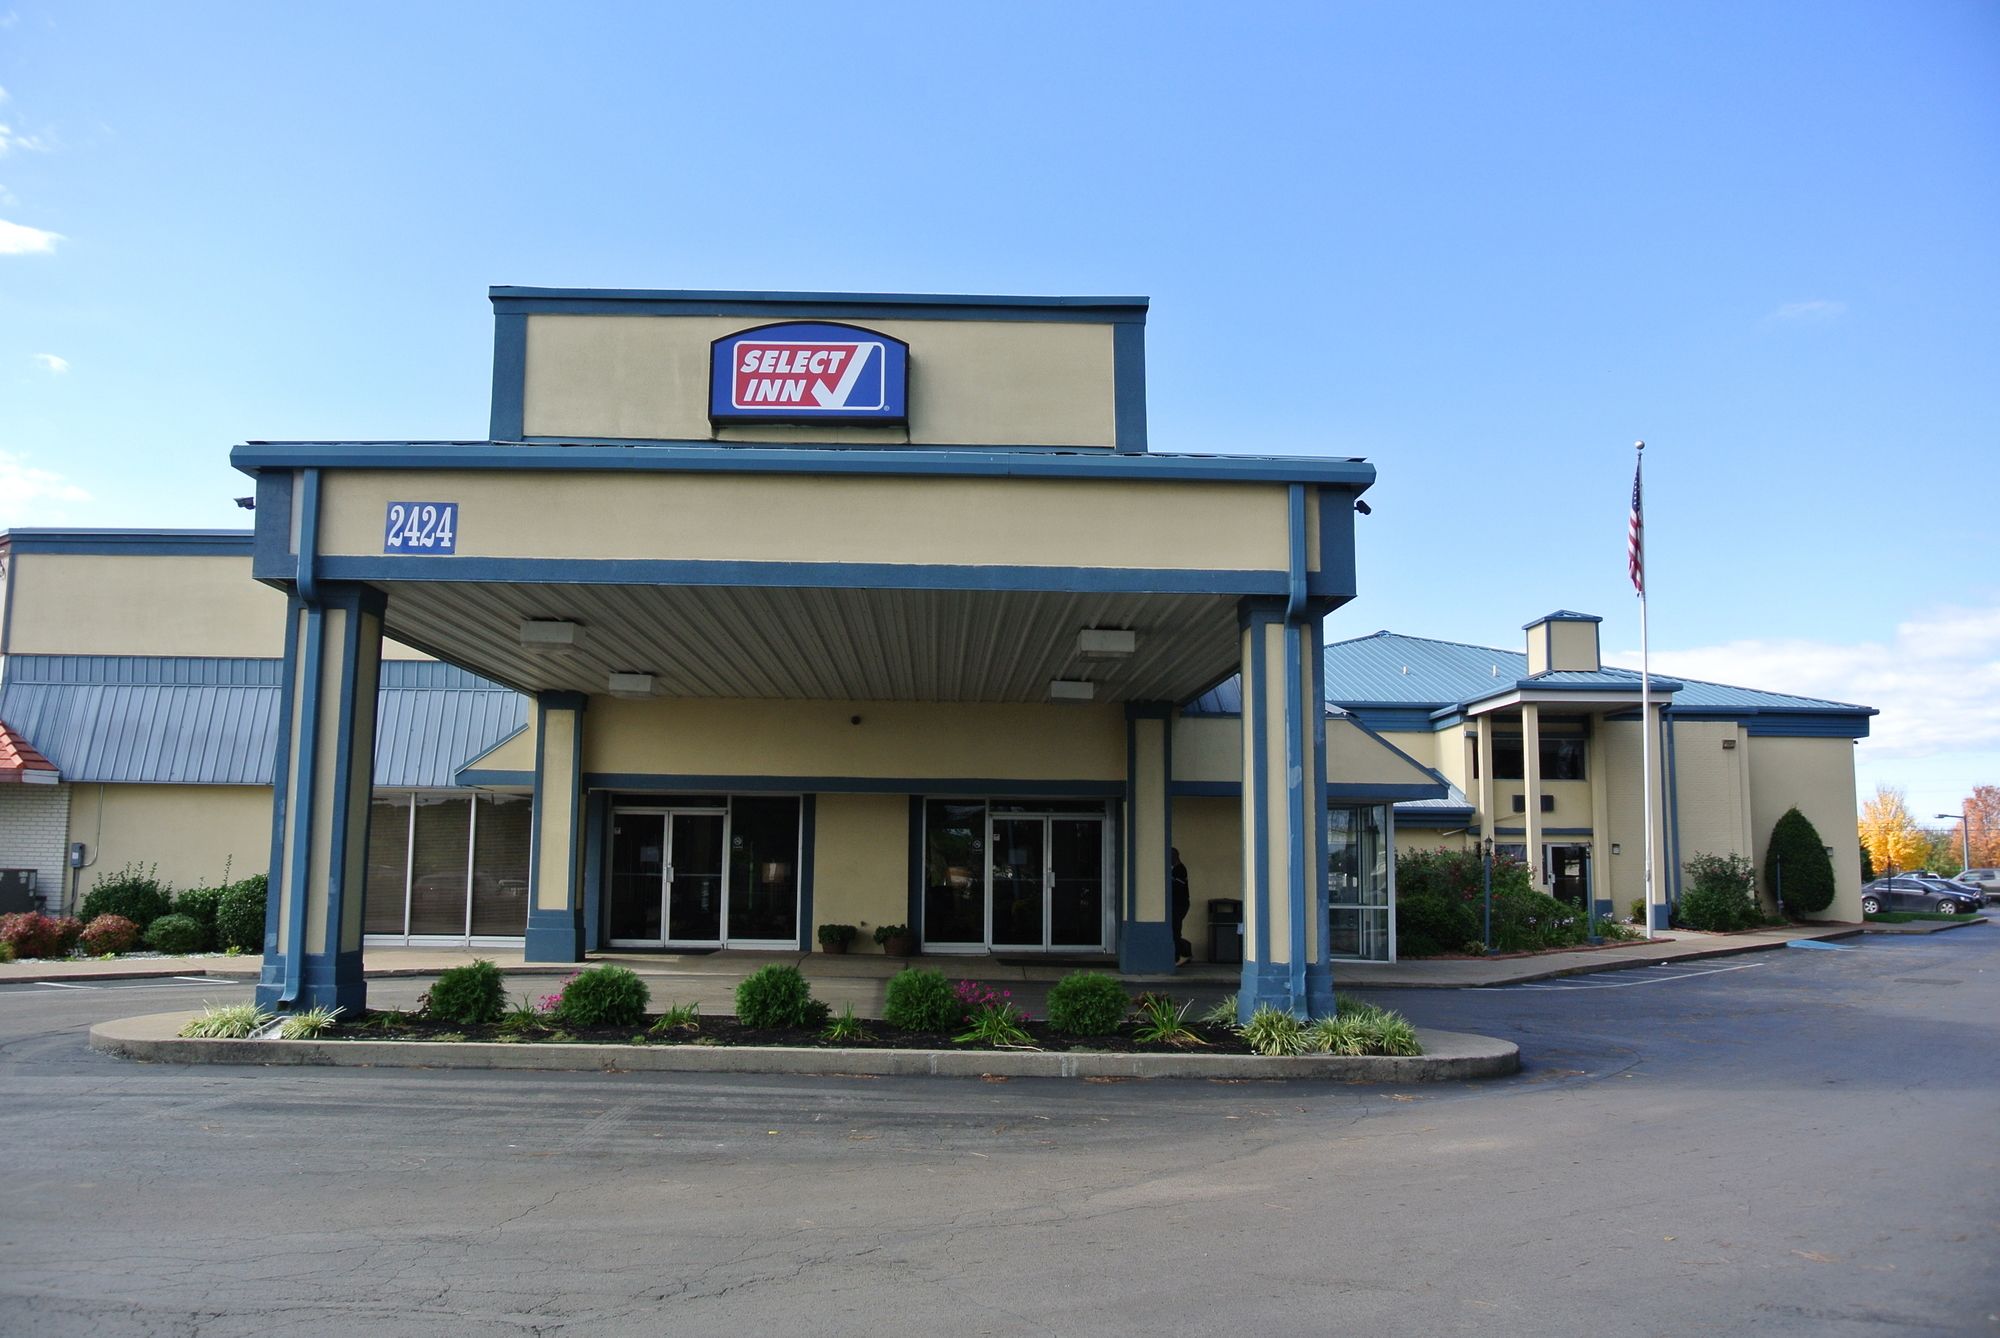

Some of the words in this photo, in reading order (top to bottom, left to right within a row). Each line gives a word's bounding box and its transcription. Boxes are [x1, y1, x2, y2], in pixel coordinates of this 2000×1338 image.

[740, 350, 847, 374] SELECT
[743, 379, 807, 402] INN
[387, 505, 453, 548] 2424
